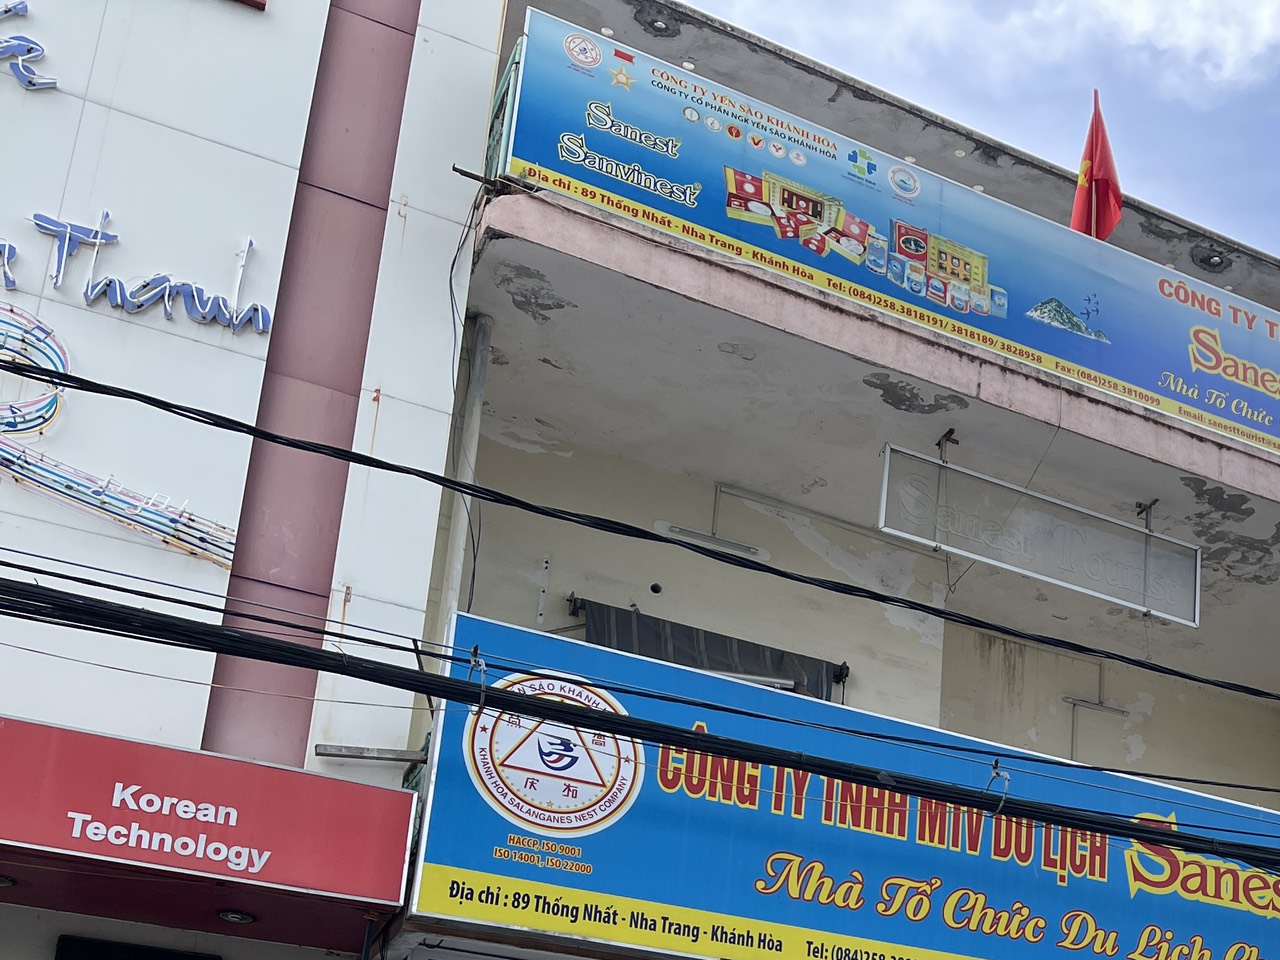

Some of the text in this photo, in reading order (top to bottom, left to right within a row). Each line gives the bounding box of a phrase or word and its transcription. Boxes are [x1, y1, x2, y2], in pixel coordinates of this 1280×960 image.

[586, 101, 681, 159] Sanest
[651, 68, 838, 151] CÔNG TY YẾN SÀO KHÁNH HÒA
[651, 80, 676, 95] CÔNG
[678, 90, 689, 100] TY
[691, 95, 703, 106] CỔ
[731, 112, 749, 125] NGK
[769, 126, 786, 140] SÀO
[788, 136, 818, 153] KHÁNH
[819, 147, 837, 161] HÒA
[558, 132, 701, 207] Sanvinest
[527, 167, 549, 183] Địa
[552, 174, 571, 191] chỉ
[581, 187, 597, 200] 89
[600, 193, 640, 218] Thống
[642, 210, 672, 229] Nhất
[682, 224, 706, 242] Nha
[709, 232, 742, 256] Trang
[752, 248, 789, 272] Khánh
[792, 262, 814, 281] Hòa
[827, 277, 846, 293] Tel:
[1000, 341, 1043, 364] 3828958
[1055, 362, 1075, 377] Fax:
[1178, 405, 1206, 424] Email:
[1158, 278, 1222, 318] CÔNG
[1228, 304, 1257, 331] TY
[1157, 370, 1200, 400] Nhà
[1204, 388, 1230, 409] Tổ
[1231, 398, 1274, 427] Chức
[530, 681, 555, 694] SÀO
[111, 782, 238, 826] Korean
[479, 747, 628, 824] KHANH HOA SALANGANES NEST COMPANY
[67, 811, 271, 873] Technology
[493, 847, 593, 875] ISO 14001, ISO 22000
[507, 834, 582, 858] HACCP, ISO 9001
[449, 879, 474, 907] Địa
[478, 885, 501, 907] chỉ
[511, 891, 531, 911] 89
[534, 895, 579, 924] Thống
[582, 903, 618, 926] Nhất
[629, 911, 657, 932] Nha
[660, 917, 700, 943] Trang
[710, 924, 755, 950] Khánh
[757, 934, 783, 953] Hòa
[805, 940, 828, 960] Tel:
[754, 851, 865, 911] Nhà
[875, 876, 942, 922] Tổ
[943, 887, 1047, 944] Chức
[1057, 909, 1119, 957] Du
